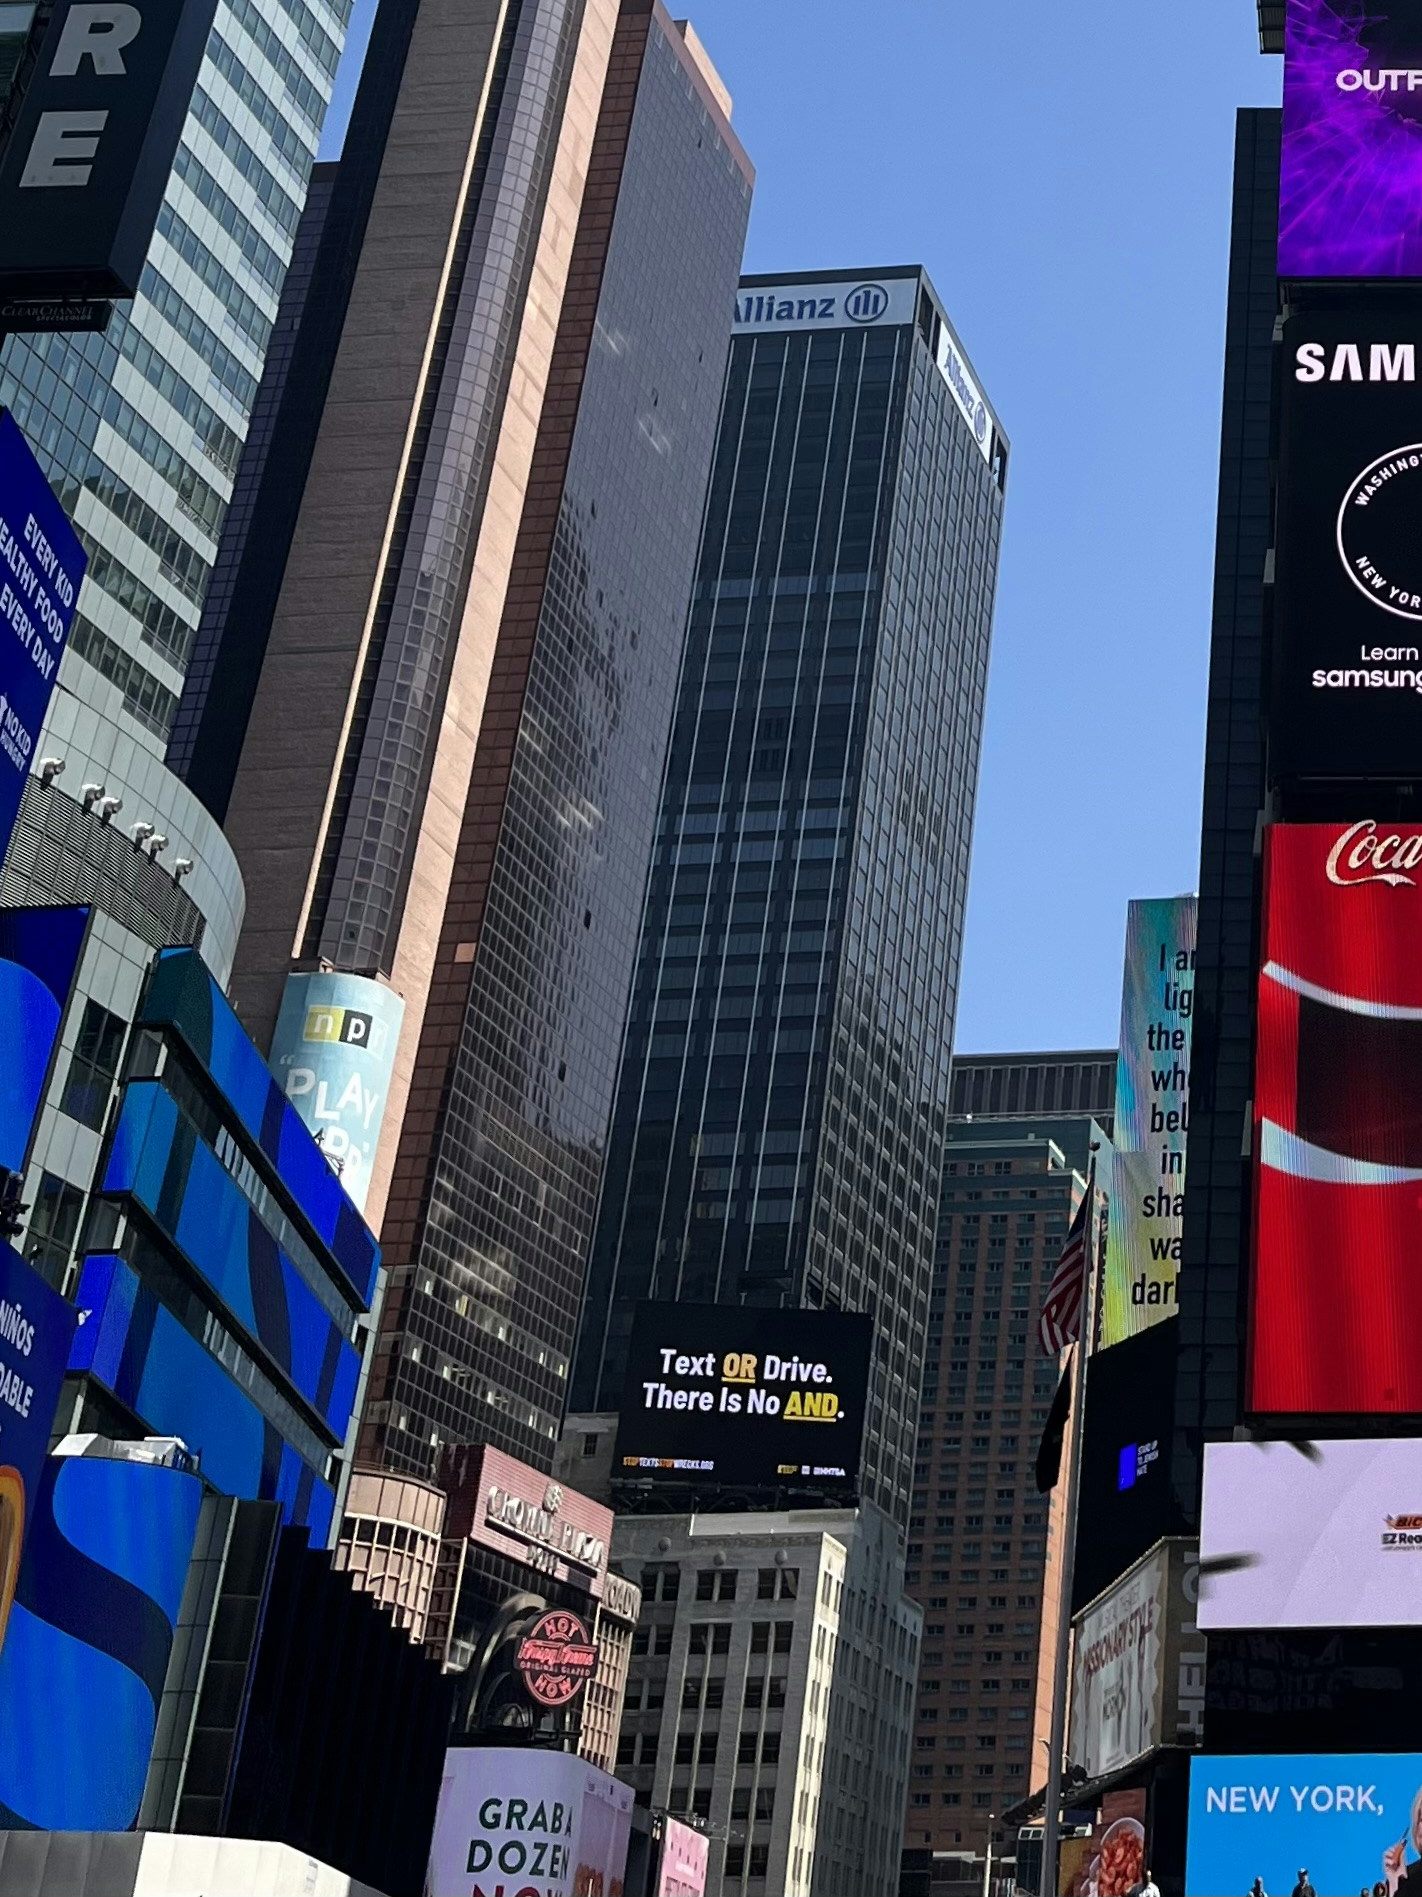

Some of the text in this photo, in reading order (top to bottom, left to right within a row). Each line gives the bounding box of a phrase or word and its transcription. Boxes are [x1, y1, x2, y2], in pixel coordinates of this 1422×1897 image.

[943, 343, 975, 421] Allianz
[23, 512, 74, 608] EVERY KID
[1355, 555, 1387, 591] NEW
[0, 582, 55, 681] EVERY DAY
[34, 585, 64, 644] FOOD
[1361, 644, 1419, 662] Learn
[1159, 943, 1167, 972] I
[1164, 981, 1194, 1019] lig
[308, 1009, 387, 1057] npr
[1147, 1022, 1185, 1052] the
[1150, 1102, 1189, 1133] bel
[1161, 1145, 1183, 1175] in
[1142, 1187, 1185, 1218] sha
[1150, 1236, 1184, 1261] wa
[1131, 1272, 1179, 1306] dar
[660, 1348, 833, 1384] Text OR Drive.
[642, 1382, 845, 1419] There Is No AND.
[544, 1617, 579, 1638] HOT
[534, 1674, 572, 1698] NOW
[478, 1798, 573, 1838] GRAB A
[1206, 1785, 1384, 1816] NEW YORK,
[466, 1839, 571, 1881] DOZEN
